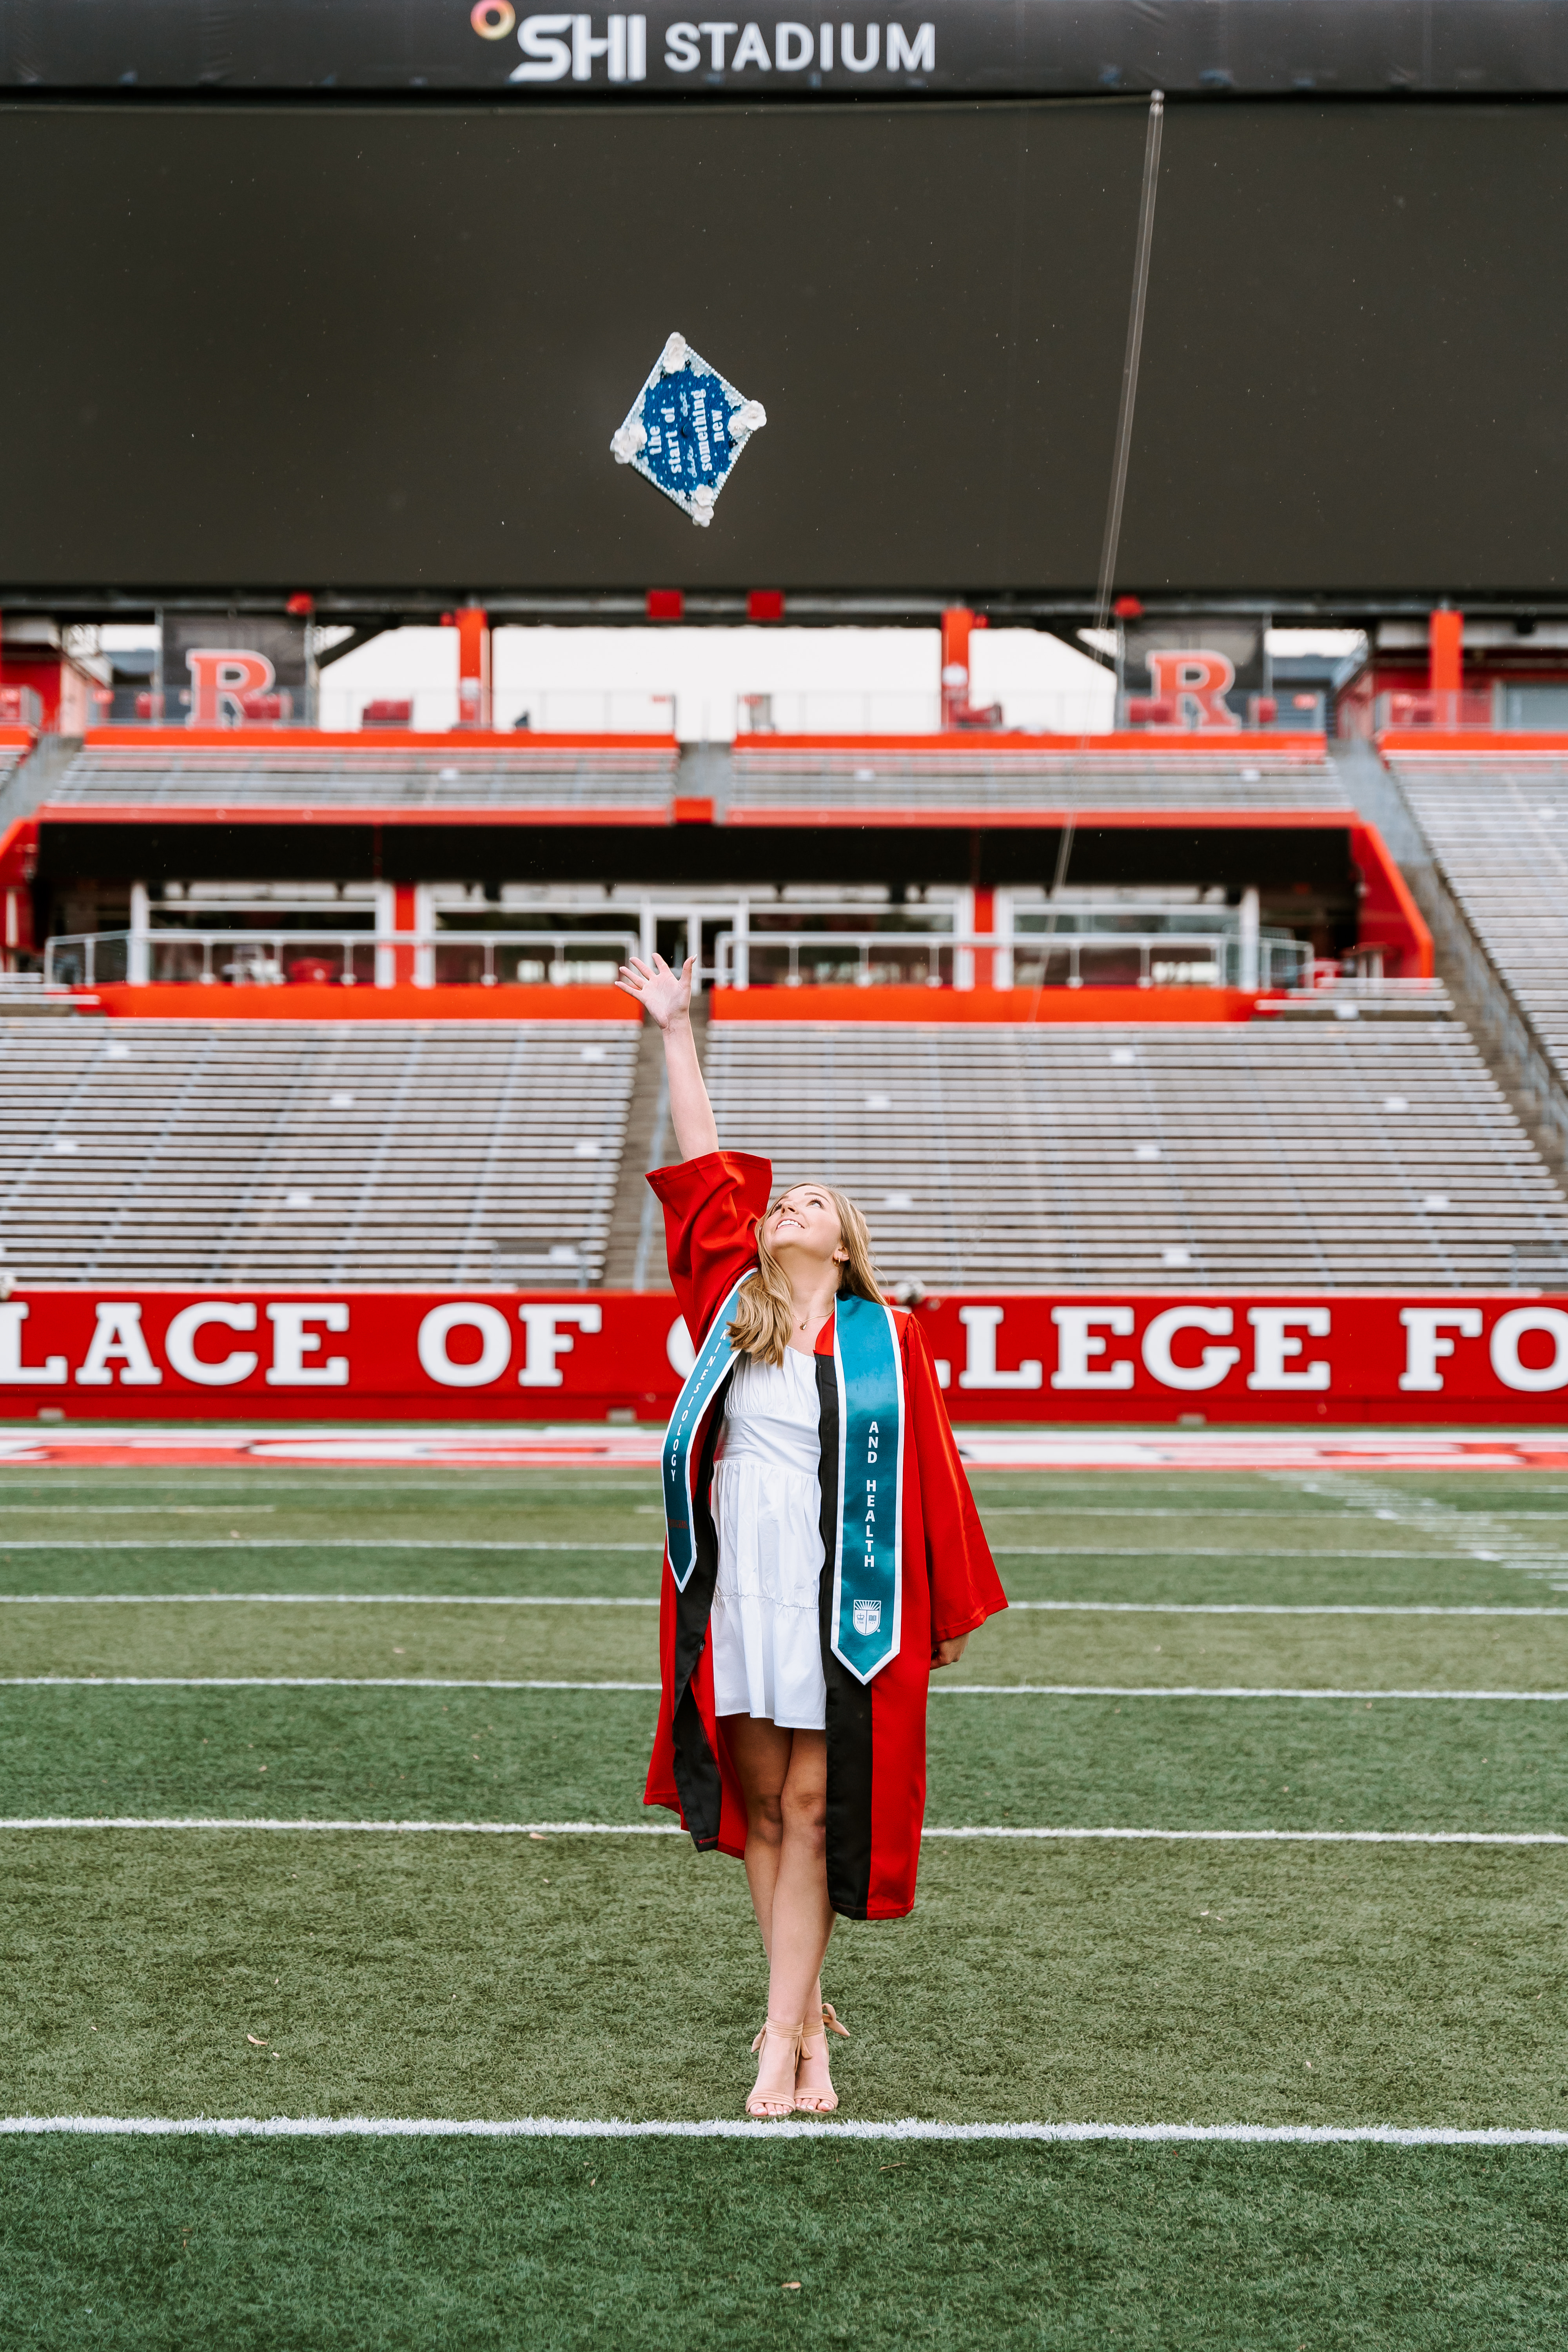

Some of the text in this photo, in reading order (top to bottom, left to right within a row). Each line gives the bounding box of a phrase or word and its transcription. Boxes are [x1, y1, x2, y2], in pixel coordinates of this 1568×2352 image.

[509, 14, 935, 81] SHI STADIUM
[648, 425, 662, 455] the
[661, 407, 682, 474] start of
[691, 388, 712, 472] something
[711, 409, 725, 443] new
[185, 648, 281, 731] R
[1145, 650, 1241, 732] R
[418, 1301, 601, 1387] OF
[1399, 1307, 1568, 1392] FO
[671, 1328, 728, 1481] KINESIOLOGY
[864, 1421, 879, 1567] AND HEALTH
